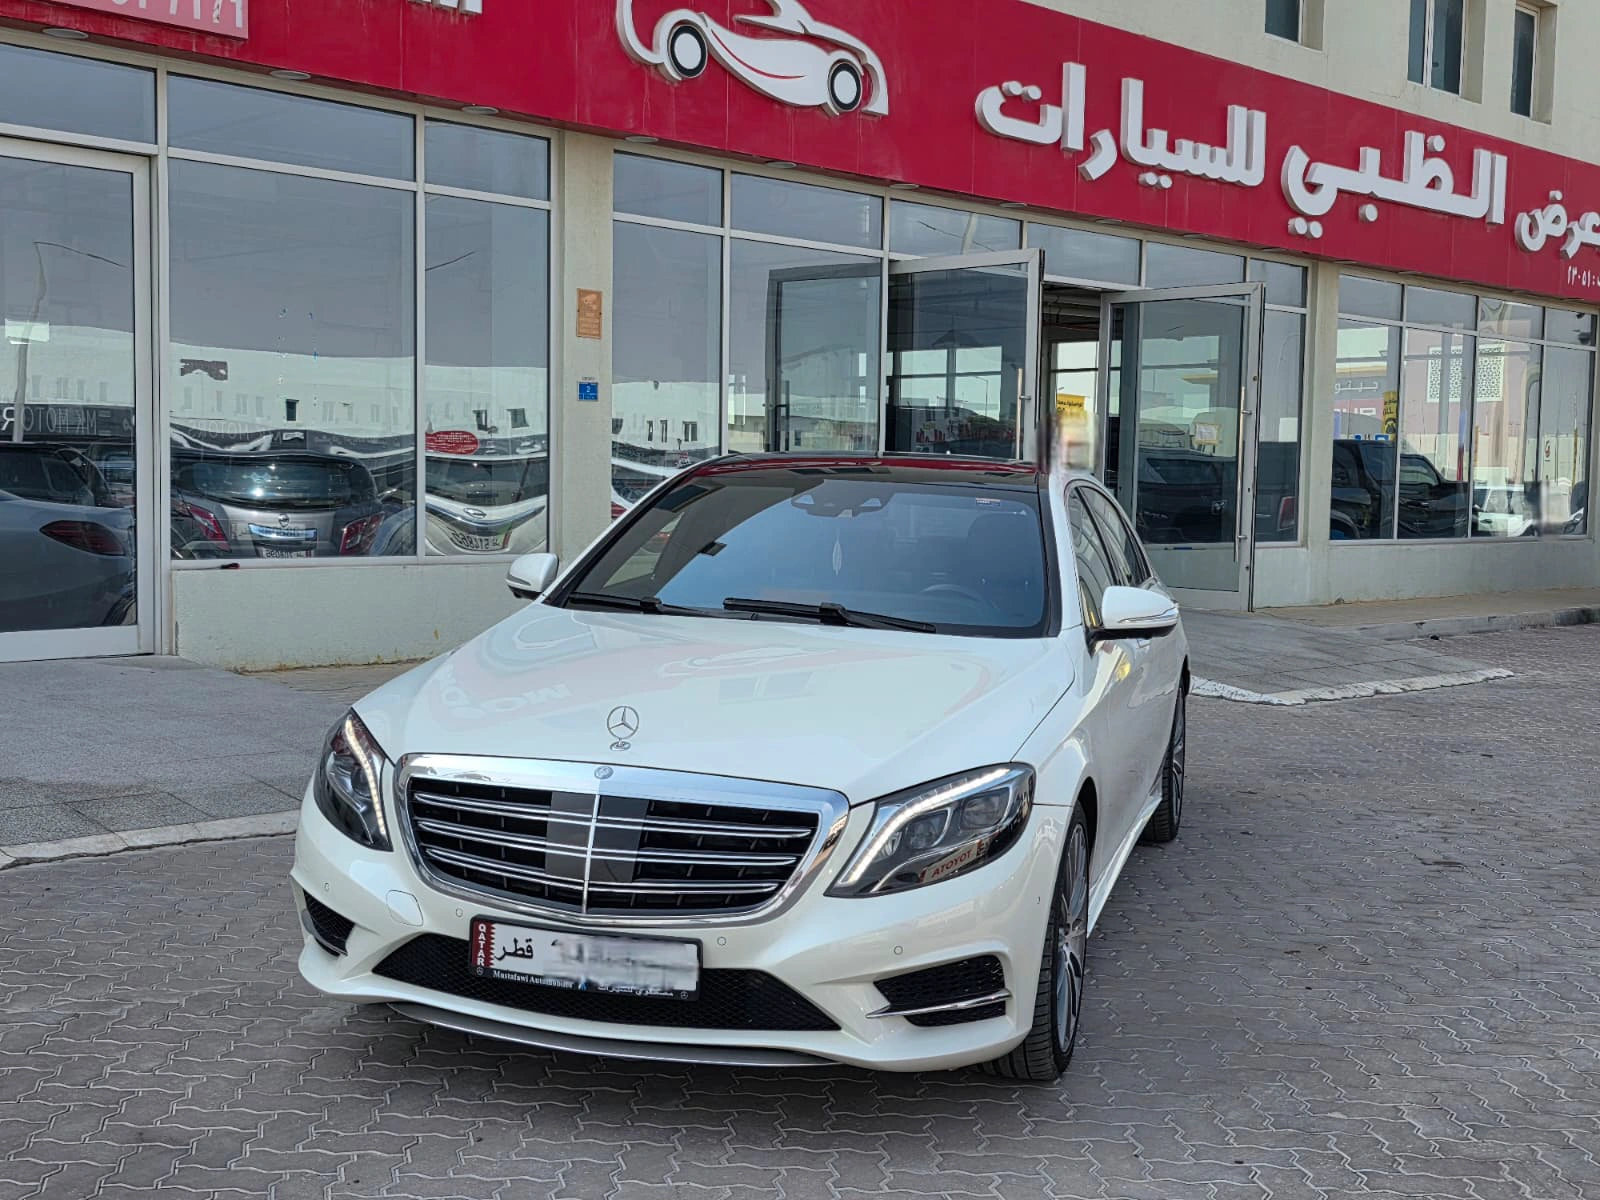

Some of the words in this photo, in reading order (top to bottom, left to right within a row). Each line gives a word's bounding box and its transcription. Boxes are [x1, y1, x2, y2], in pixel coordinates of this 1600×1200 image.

[975, 62, 1266, 189] للسيارات
[1281, 131, 1506, 240] الظبي
[476, 923, 486, 966] QATAR
[494, 937, 533, 961] قطر
[492, 970, 529, 983] Mustafawi
